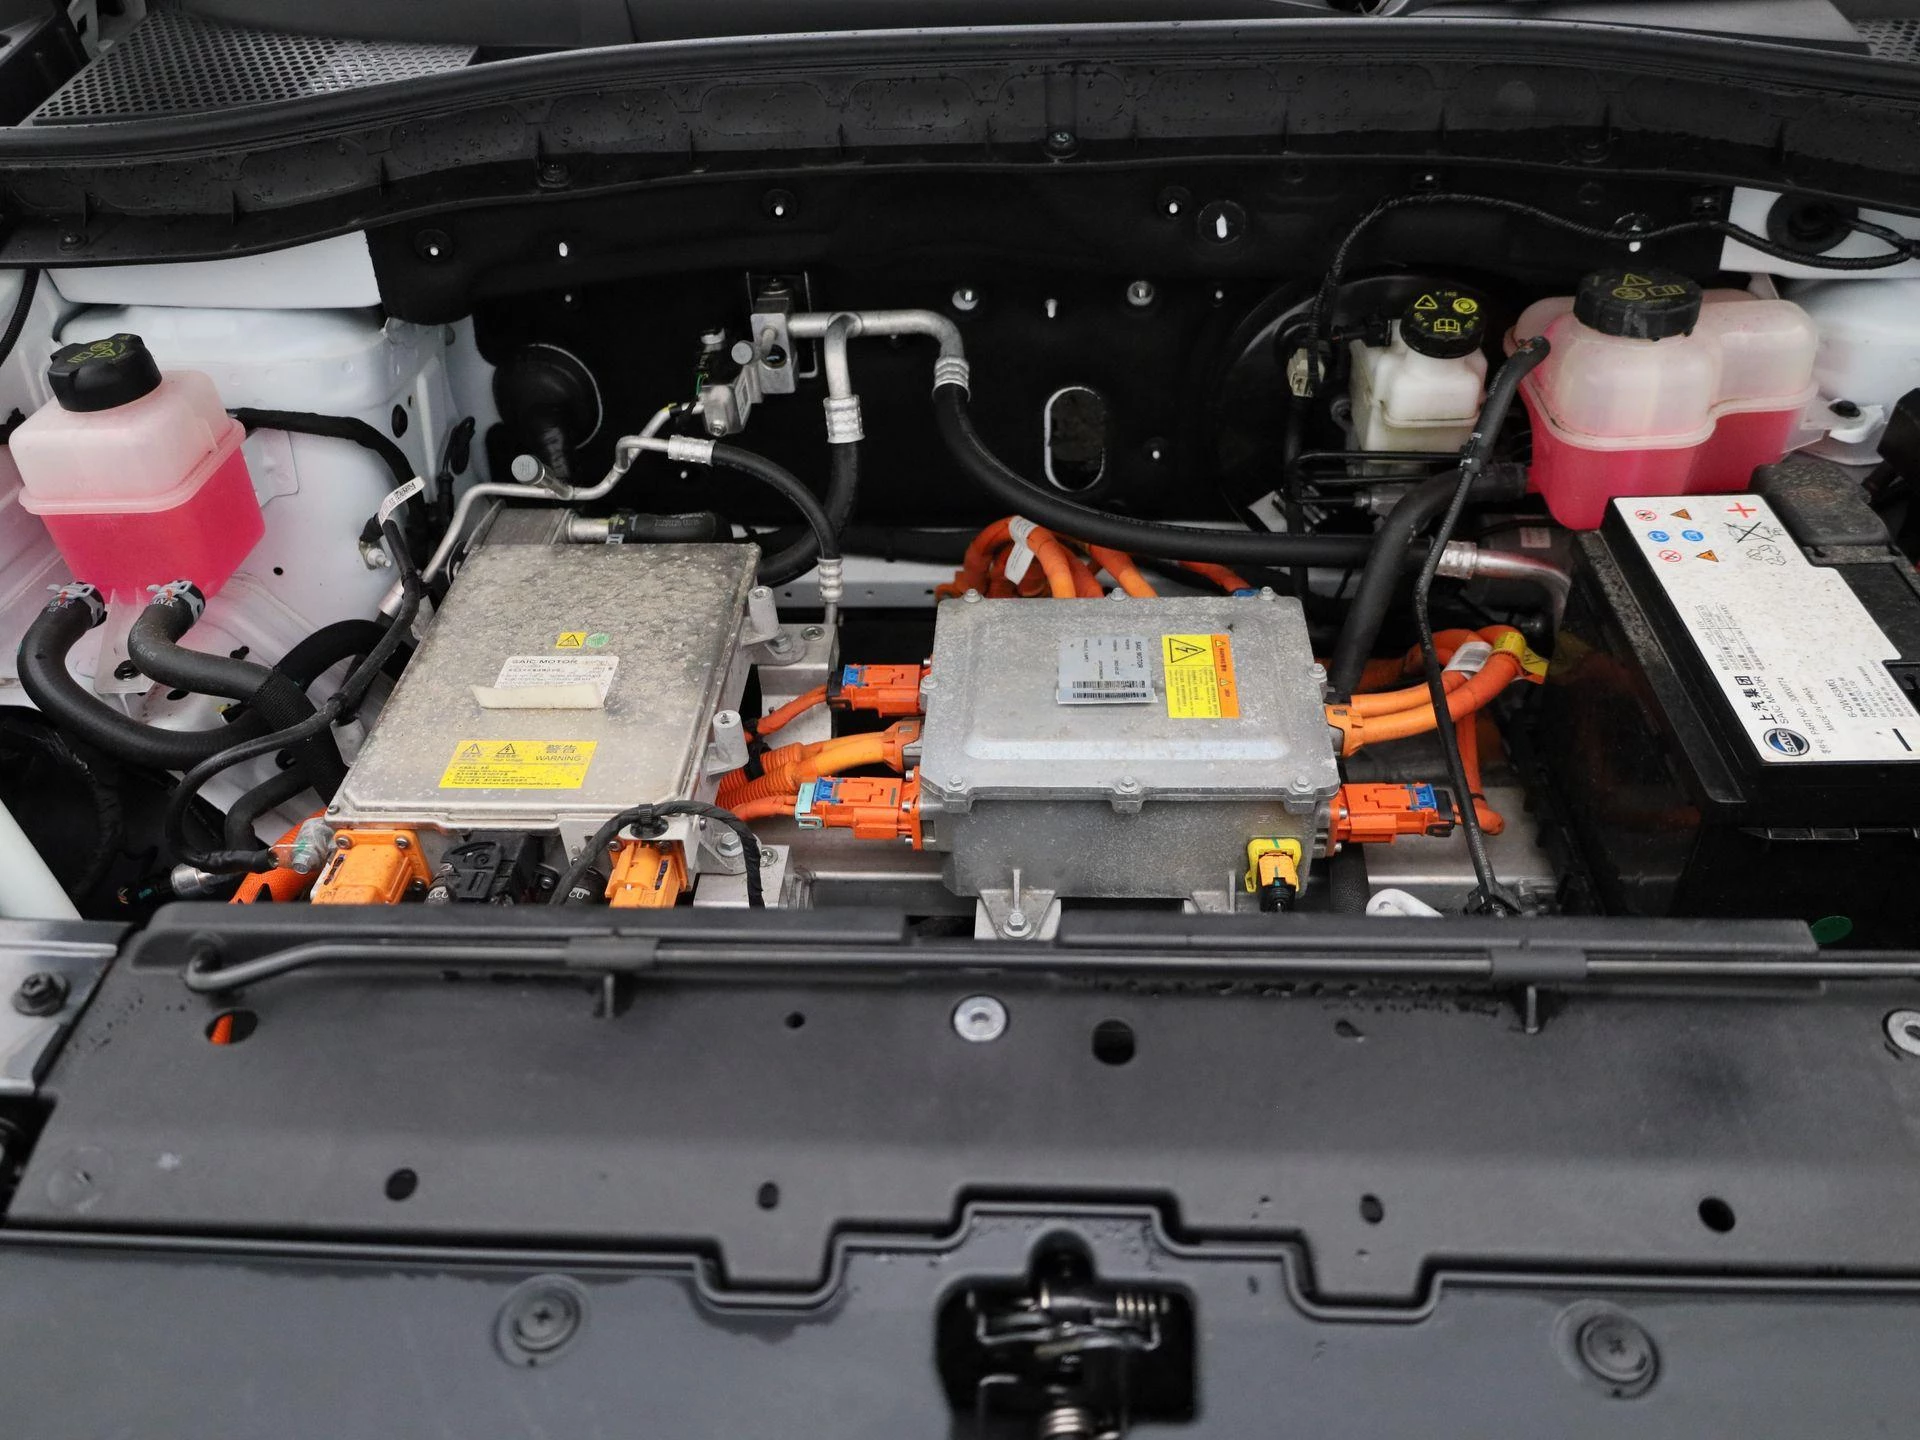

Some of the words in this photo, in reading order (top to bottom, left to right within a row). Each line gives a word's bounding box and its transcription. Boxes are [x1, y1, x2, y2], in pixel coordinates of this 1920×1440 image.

[1753, 676, 1776, 703] MOTOR
[1802, 687, 1818, 705] CHINA
[1734, 675, 1778, 724] 上汽集团
[1772, 705, 1790, 724] SAIC
[1821, 715, 1834, 731] MADE
[1803, 720, 1820, 735] PART
[1778, 731, 1797, 753] SAIC
